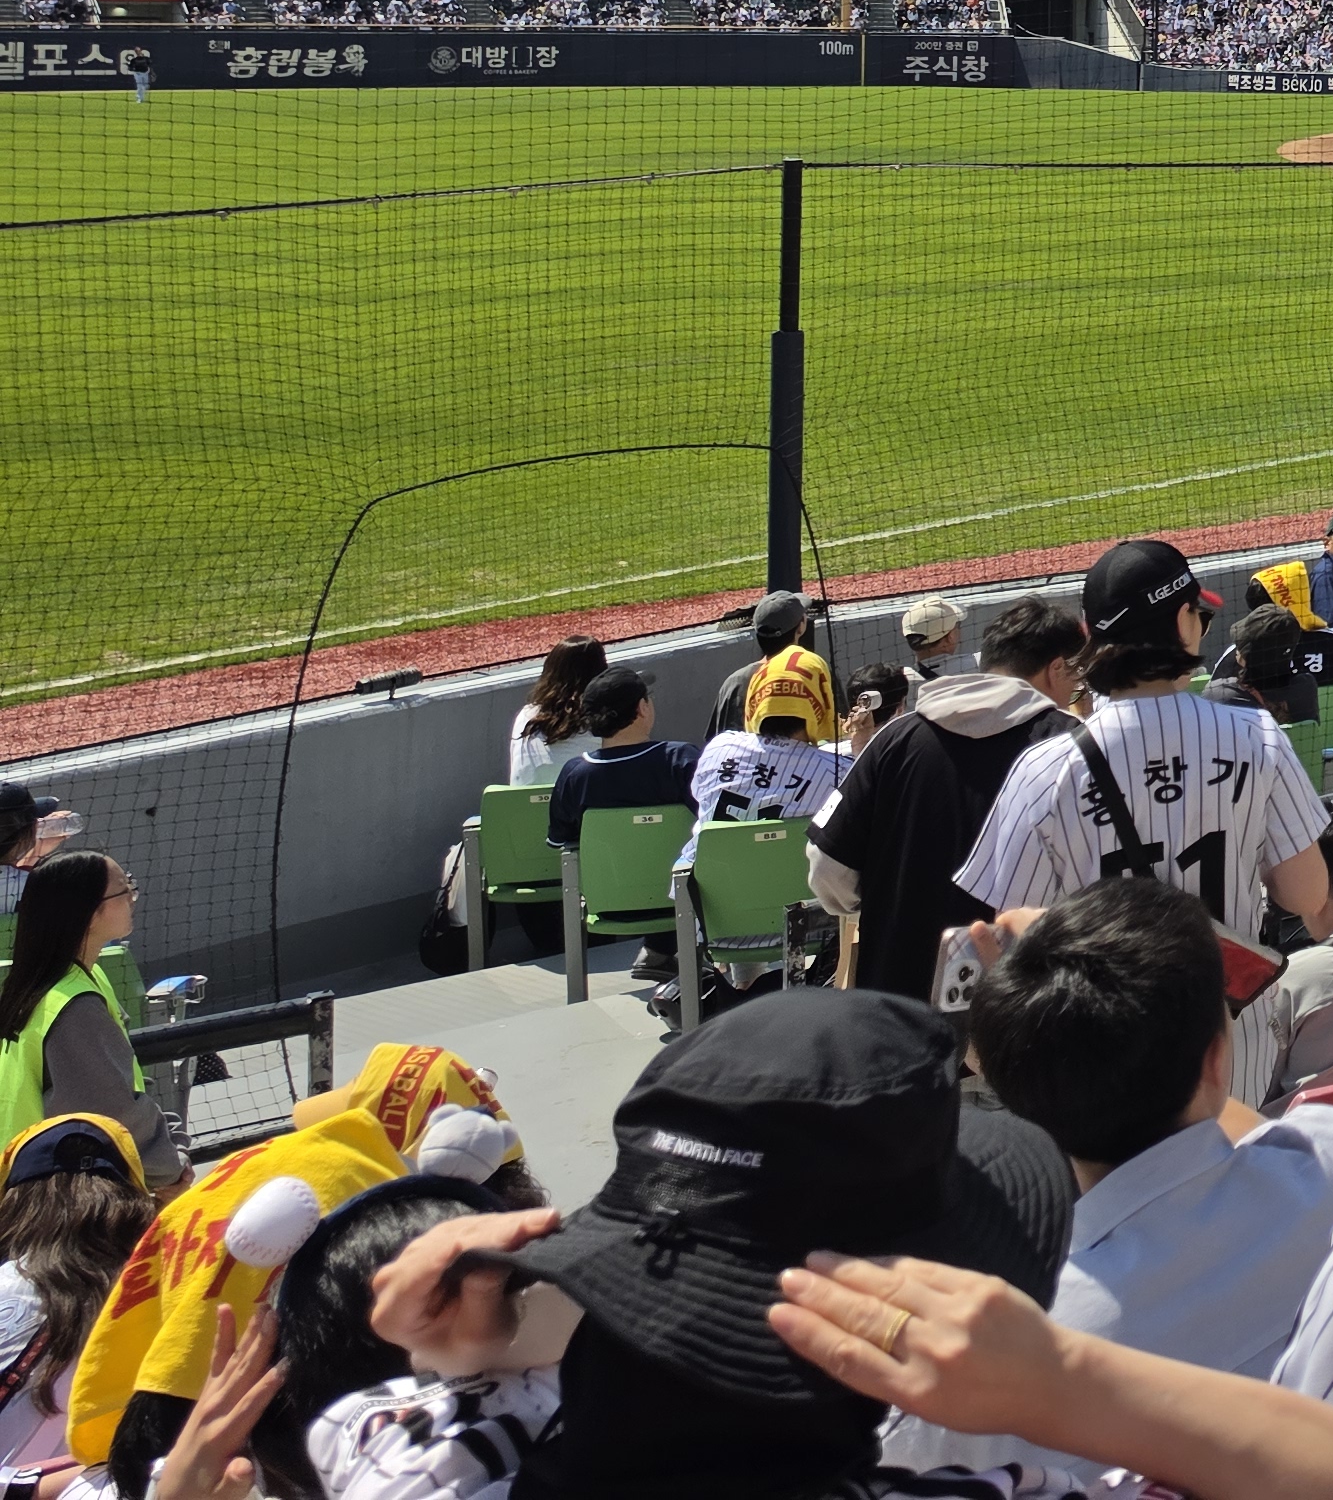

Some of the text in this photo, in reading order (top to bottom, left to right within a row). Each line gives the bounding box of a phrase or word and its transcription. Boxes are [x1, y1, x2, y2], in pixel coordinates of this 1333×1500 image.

[818, 40, 854, 55] 100m
[914, 41, 943, 52] 200만
[902, 55, 989, 83] 주식창
[1226, 73, 1276, 92] 백조씽크
[1147, 573, 1194, 606] LGE.COM
[715, 758, 813, 804] 홍창기
[652, 1129, 765, 1169] THE NORTH FACE
